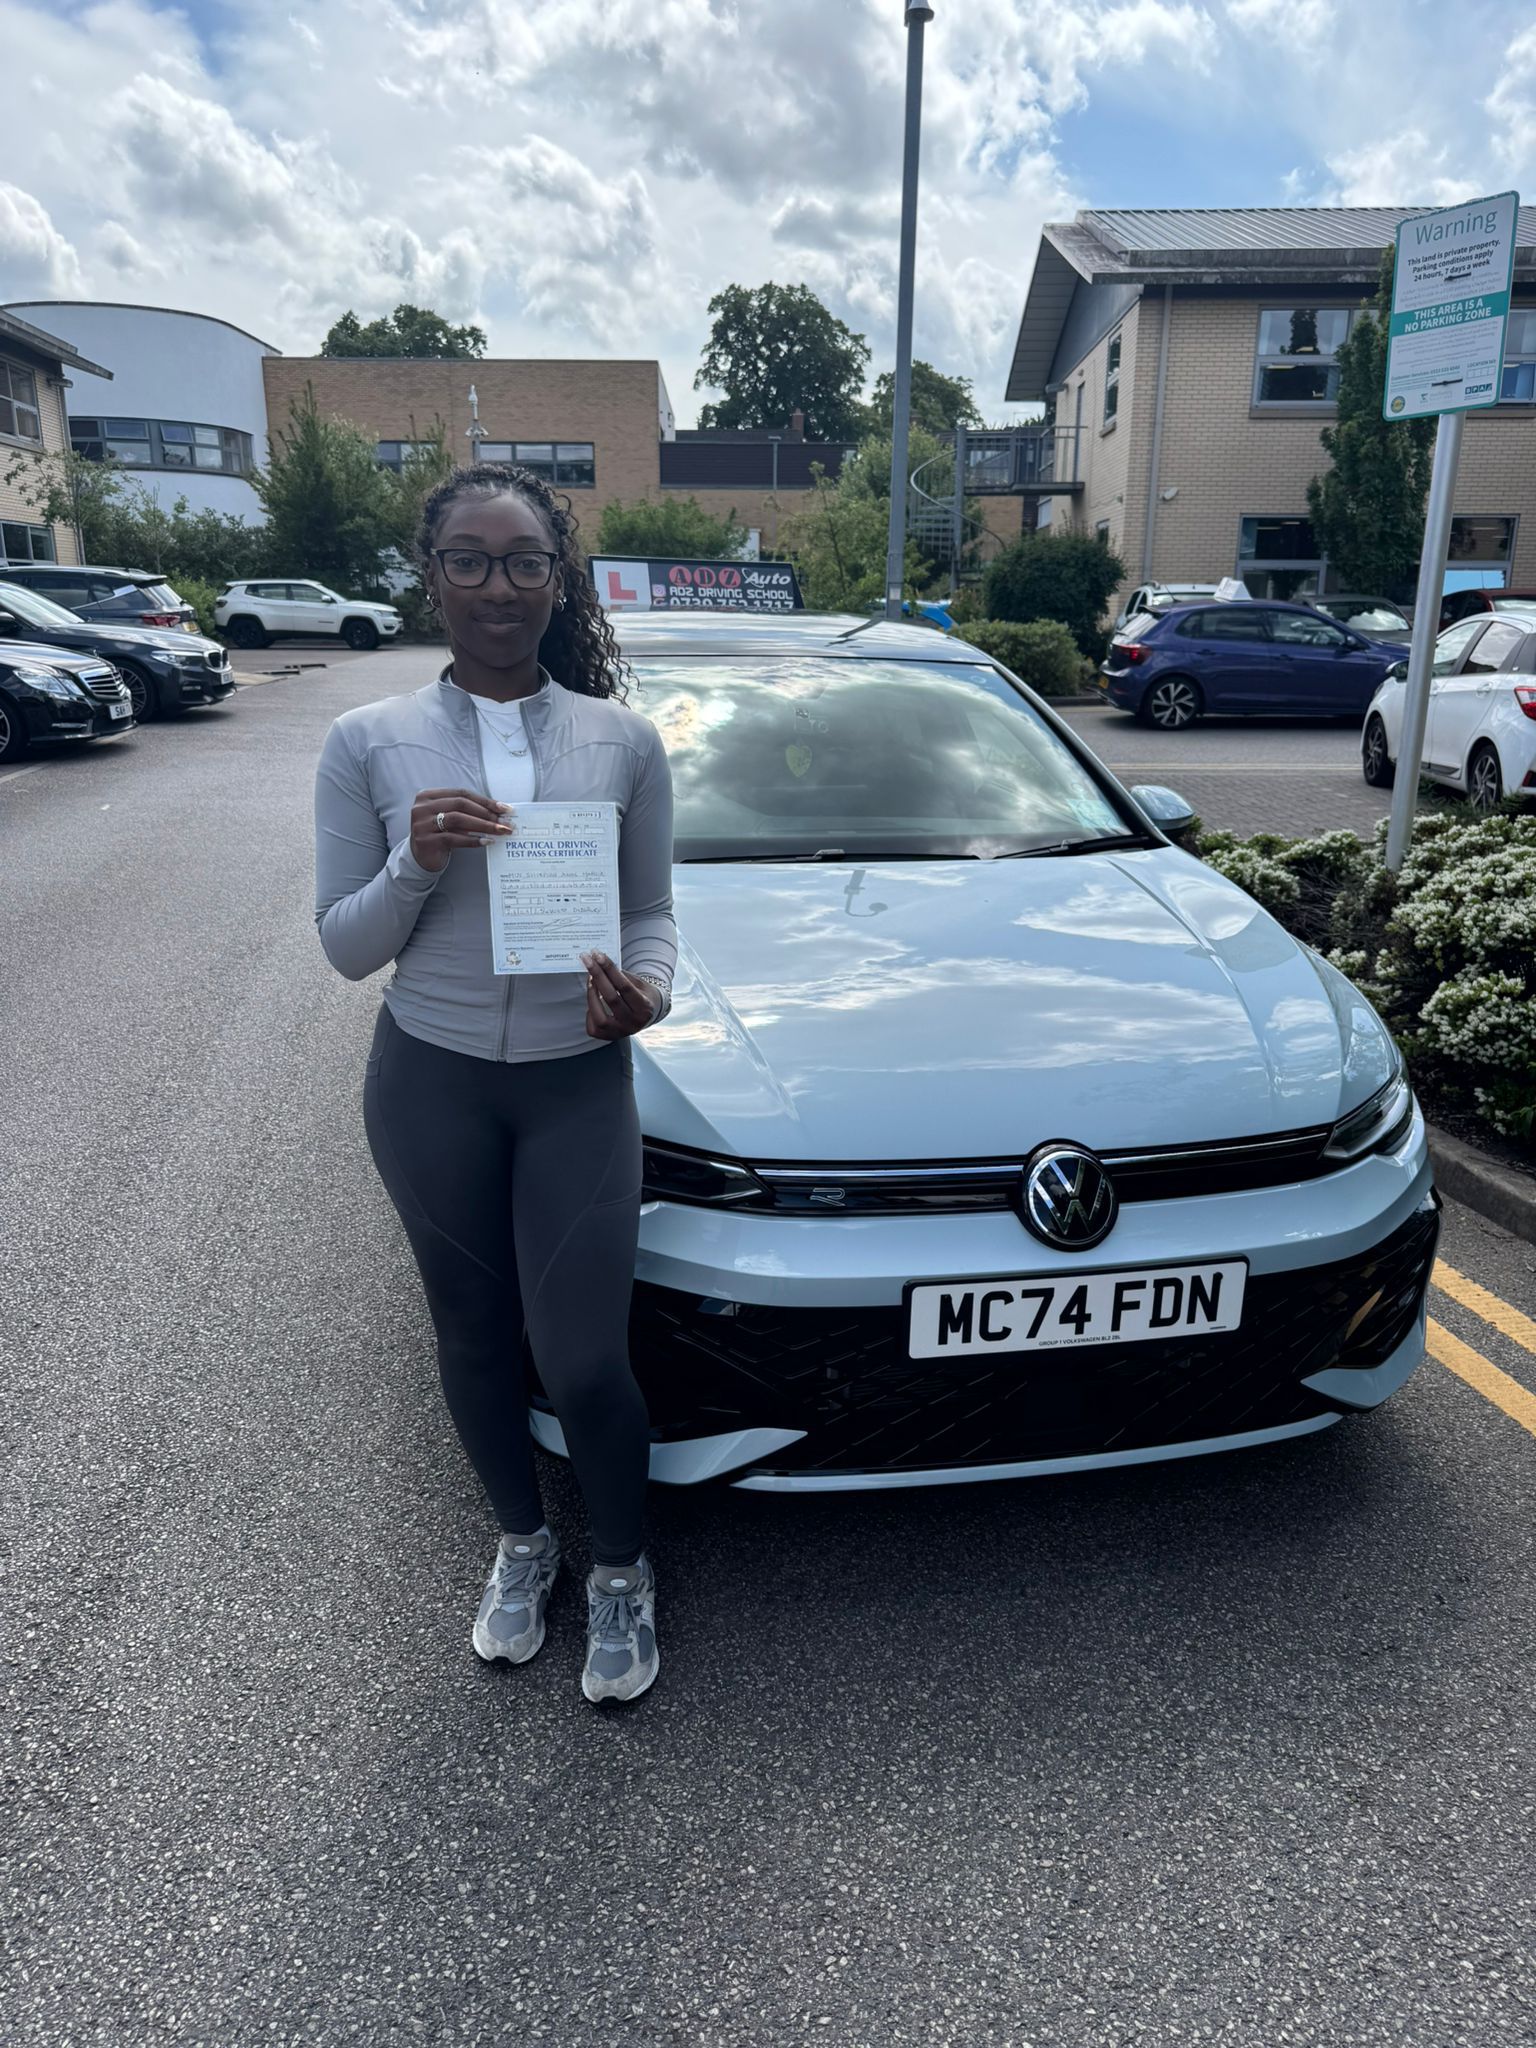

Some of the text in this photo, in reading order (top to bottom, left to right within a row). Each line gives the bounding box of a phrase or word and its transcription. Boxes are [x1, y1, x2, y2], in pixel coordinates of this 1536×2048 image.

[1416, 210, 1498, 245] Warning
[1408, 239, 1500, 266] This land is private property.
[1412, 250, 1494, 274] Parking conditions apply
[1414, 274, 1422, 282] 24
[1422, 270, 1444, 280] hours,
[1450, 264, 1466, 275] days
[1473, 259, 1490, 268] week
[1404, 307, 1492, 333] NO PARKING ZONE
[1414, 298, 1484, 321] THIS AREA IS A
[608, 571, 638, 600] L
[745, 570, 791, 587] Auto
[670, 587, 794, 600] ADZ DRIVING SCHOOL
[506, 840, 598, 849] PRACTICAL DRIVING
[507, 850, 524, 858] TEST
[937, 1271, 1223, 1346] MC74 FDN
[1063, 1336, 1101, 1344] VOLKSWAGEN
